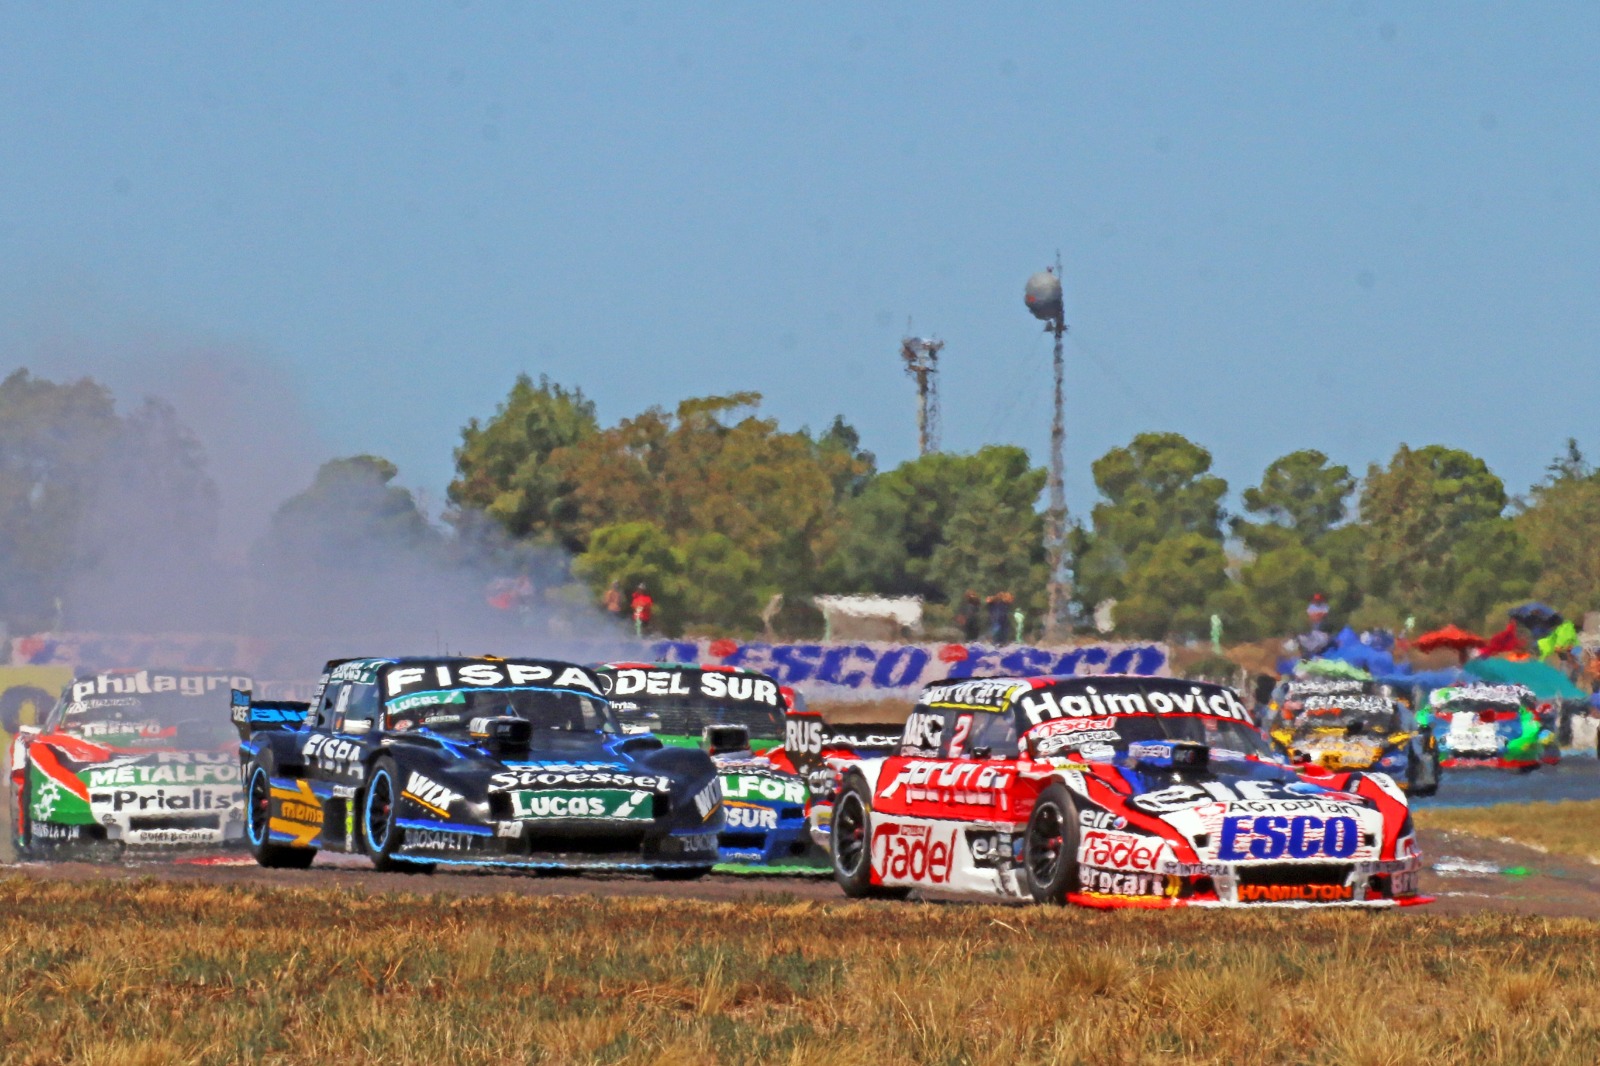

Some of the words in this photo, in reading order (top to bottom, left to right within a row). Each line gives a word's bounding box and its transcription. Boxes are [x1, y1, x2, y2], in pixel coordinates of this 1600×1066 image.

[73, 671, 253, 702] philagro
[386, 663, 605, 697] FISPA
[616, 669, 690, 696] DEL
[701, 671, 777, 706] SUR
[1021, 685, 1256, 727] Haimovich
[785, 720, 822, 753] RUS
[488, 771, 671, 793] Stoessel
[511, 791, 606, 818] Lucas
[725, 807, 778, 829] SUR
[1079, 809, 1116, 829] elf
[871, 822, 958, 884] Fadel
[1084, 831, 1166, 871] Fadel
[1217, 815, 1358, 861] ESCO
[1237, 884, 1352, 902] HAMILTON
